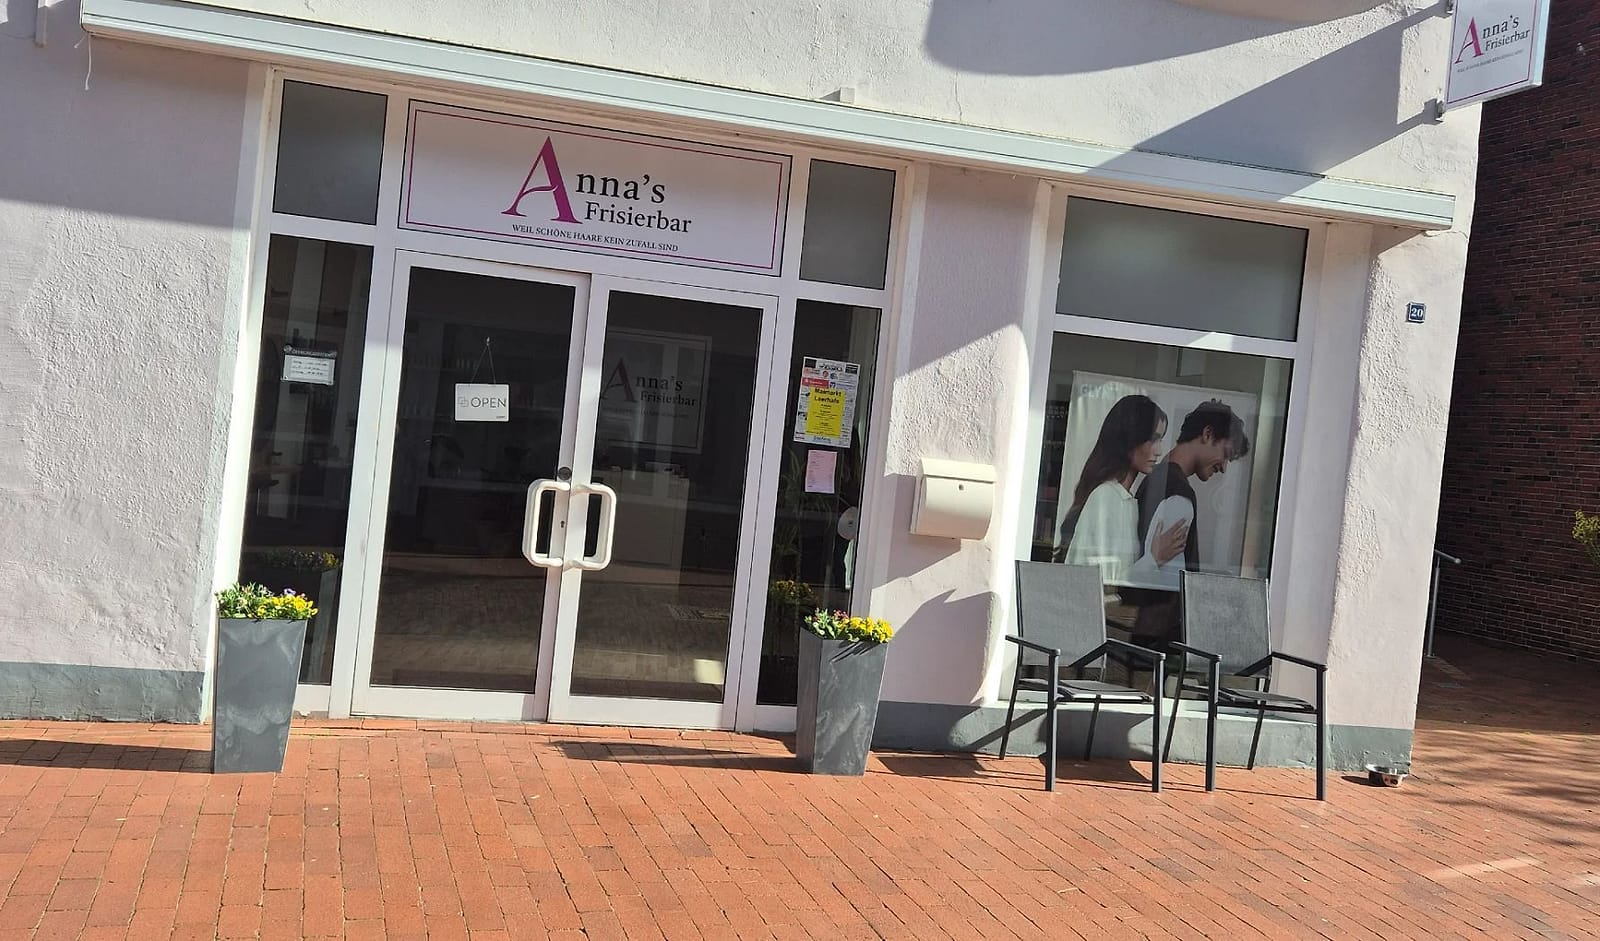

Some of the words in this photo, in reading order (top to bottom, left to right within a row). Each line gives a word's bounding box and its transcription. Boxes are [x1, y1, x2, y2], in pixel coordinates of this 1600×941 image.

[1454, 15, 1519, 64] Anna's
[1485, 29, 1530, 51] Frisierbar
[501, 135, 666, 225] Anna's
[584, 201, 692, 233] Frisierbar
[512, 224, 534, 234] WEIL
[536, 226, 573, 239] SCHÖNE
[574, 232, 603, 243] HAARE
[604, 235, 626, 246] KEIN
[626, 238, 657, 250] ZUFALL
[658, 243, 679, 252] SIND
[1411, 307, 1424, 318] 20
[600, 357, 683, 403] Anna's
[471, 397, 506, 408] OPEN
[641, 391, 697, 406] Frisierbar
